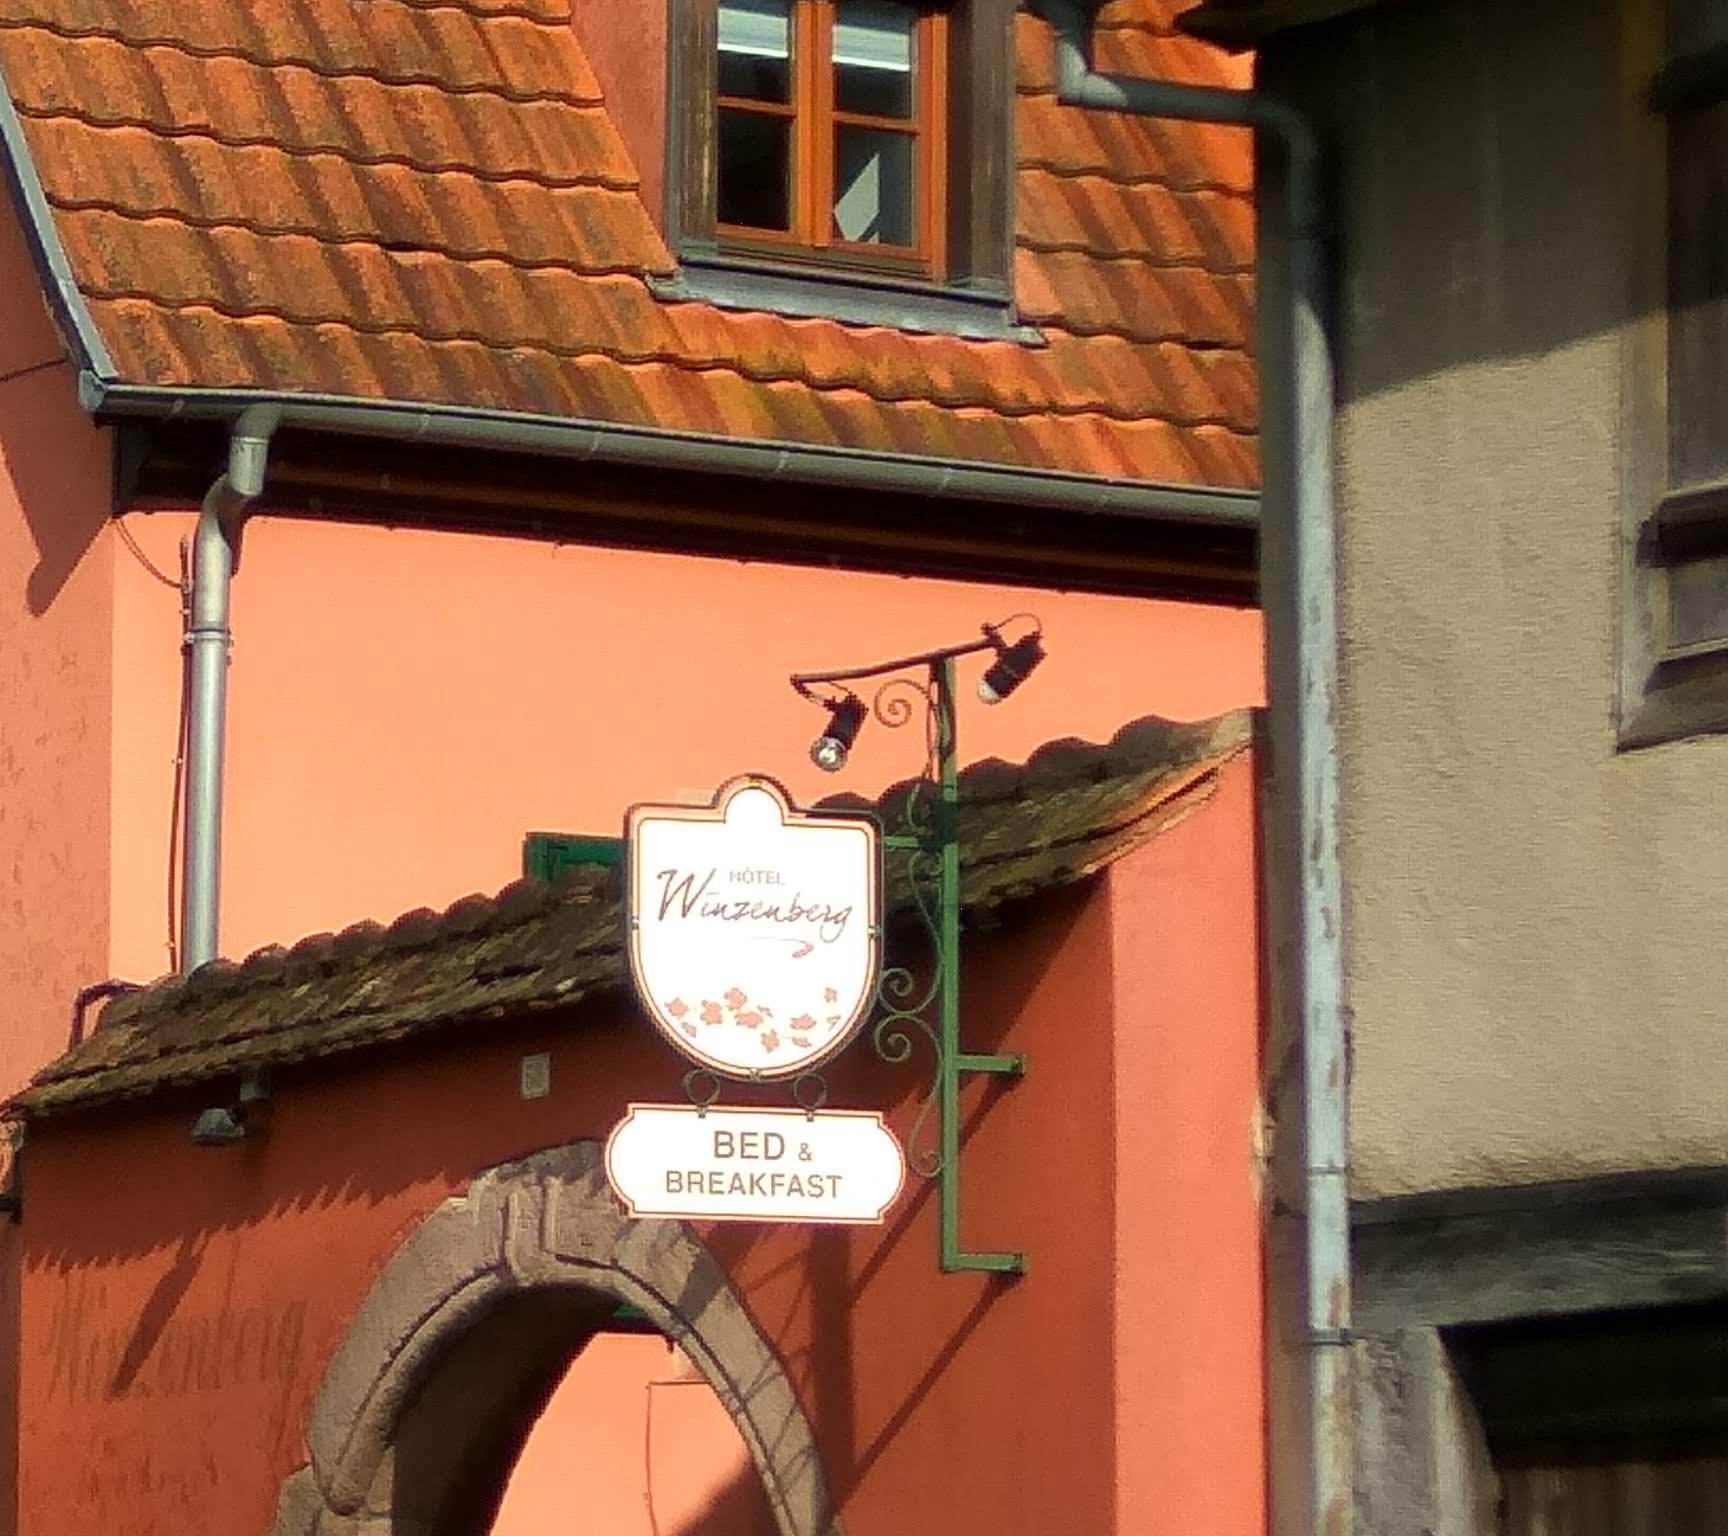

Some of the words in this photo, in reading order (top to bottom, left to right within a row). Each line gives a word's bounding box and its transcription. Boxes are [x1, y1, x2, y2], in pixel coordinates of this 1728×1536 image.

[656, 867, 854, 944] Winzenberg
[713, 1130, 786, 1161] BED
[798, 1142, 813, 1162] &
[665, 1170, 843, 1199] BREAKFAST
